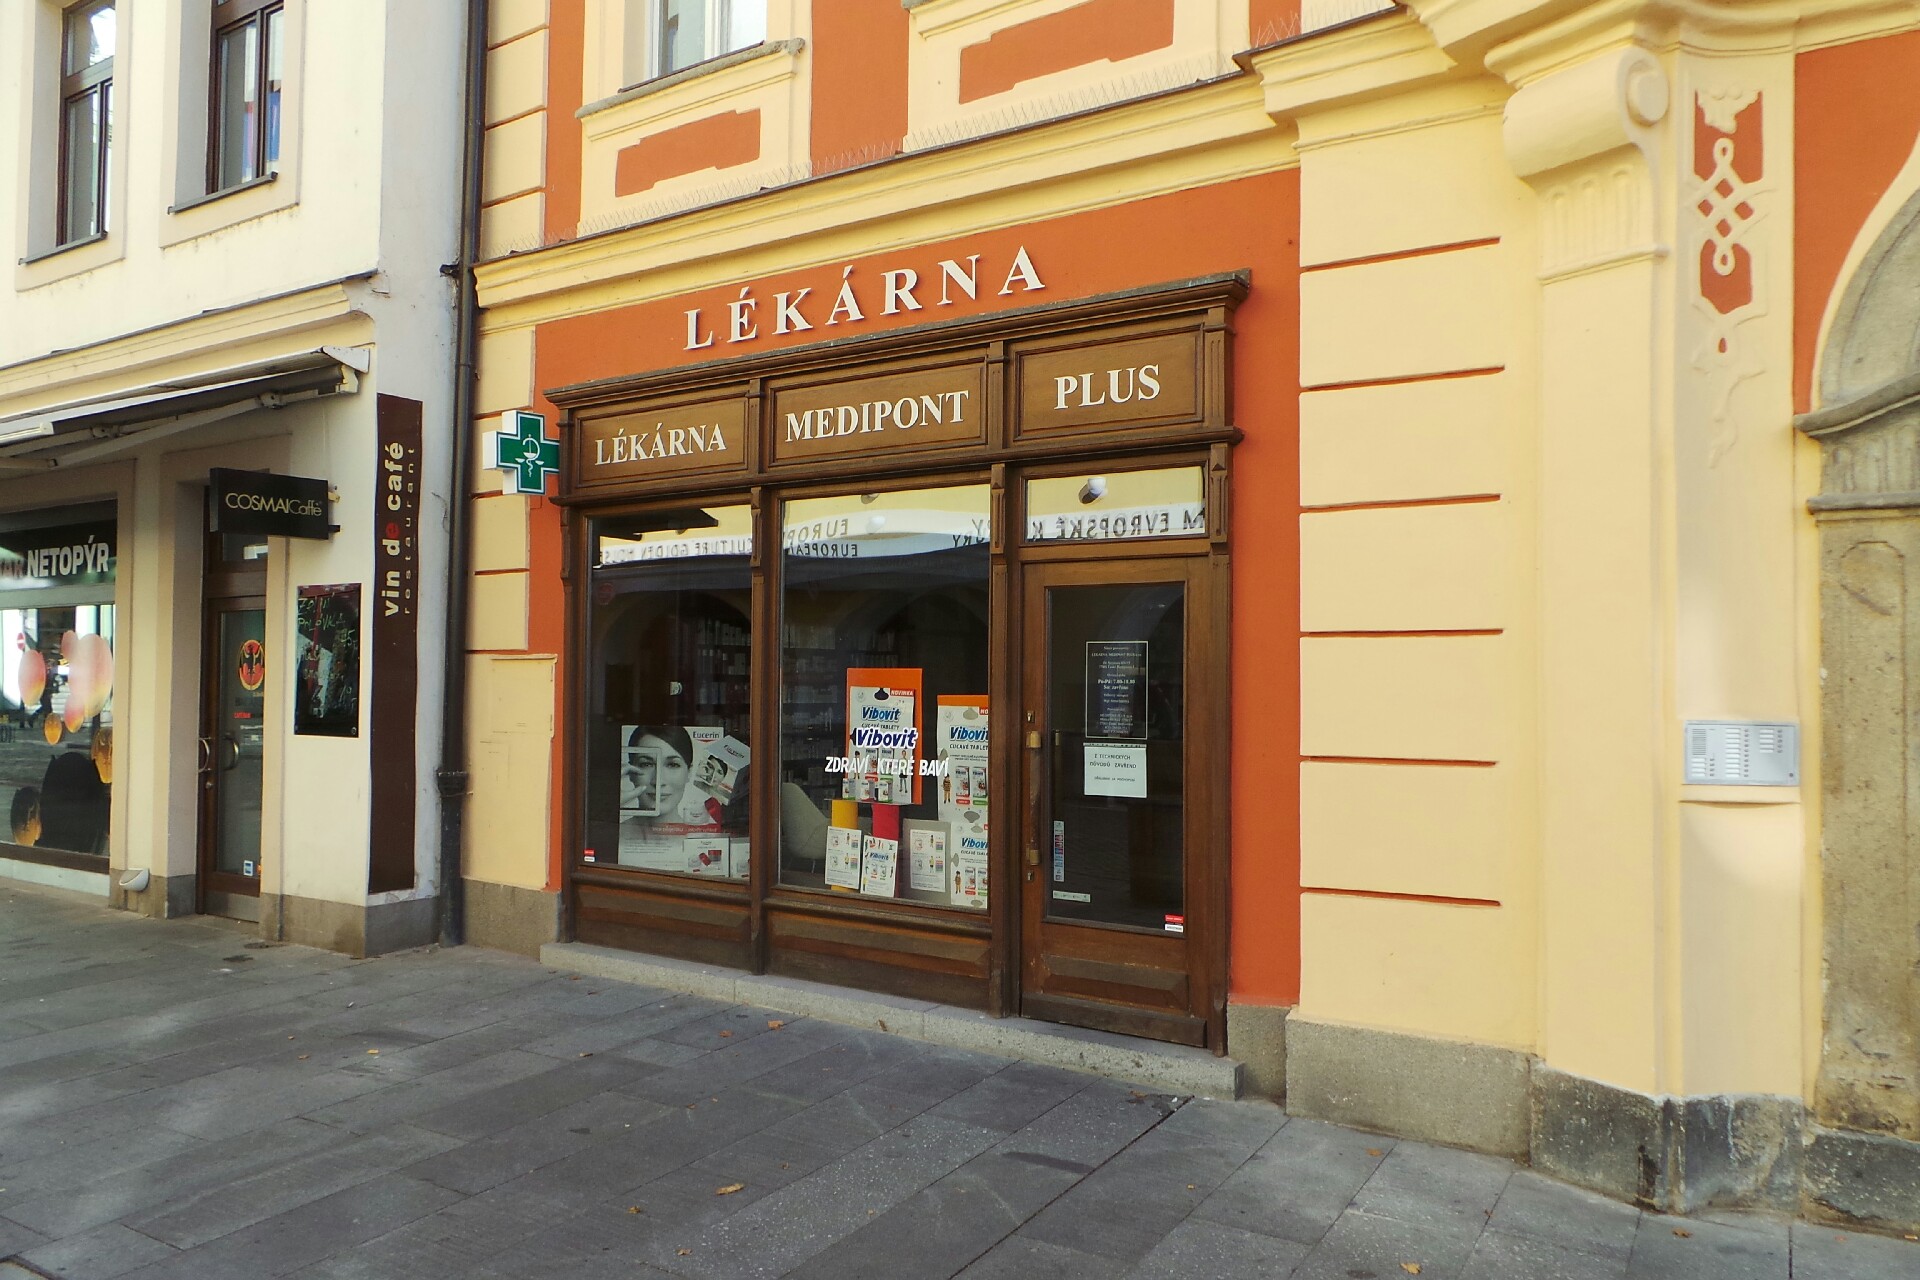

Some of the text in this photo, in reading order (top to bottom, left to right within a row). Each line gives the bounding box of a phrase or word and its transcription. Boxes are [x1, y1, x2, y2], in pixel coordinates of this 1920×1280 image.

[682, 245, 1047, 352] LÉKÁRNA
[593, 363, 1161, 467] LÉKÁRNA MEDIPONT PLUS
[381, 442, 404, 616] vin de café
[404, 447, 415, 615] restaurant
[27, 535, 109, 578] NETOPÝR
[692, 731, 720, 740] Eucerin
[861, 705, 901, 723] Vibovit
[856, 727, 918, 749] Vibovit
[825, 754, 950, 777] ZDRAVÍ KTERÉ BAVÍ
